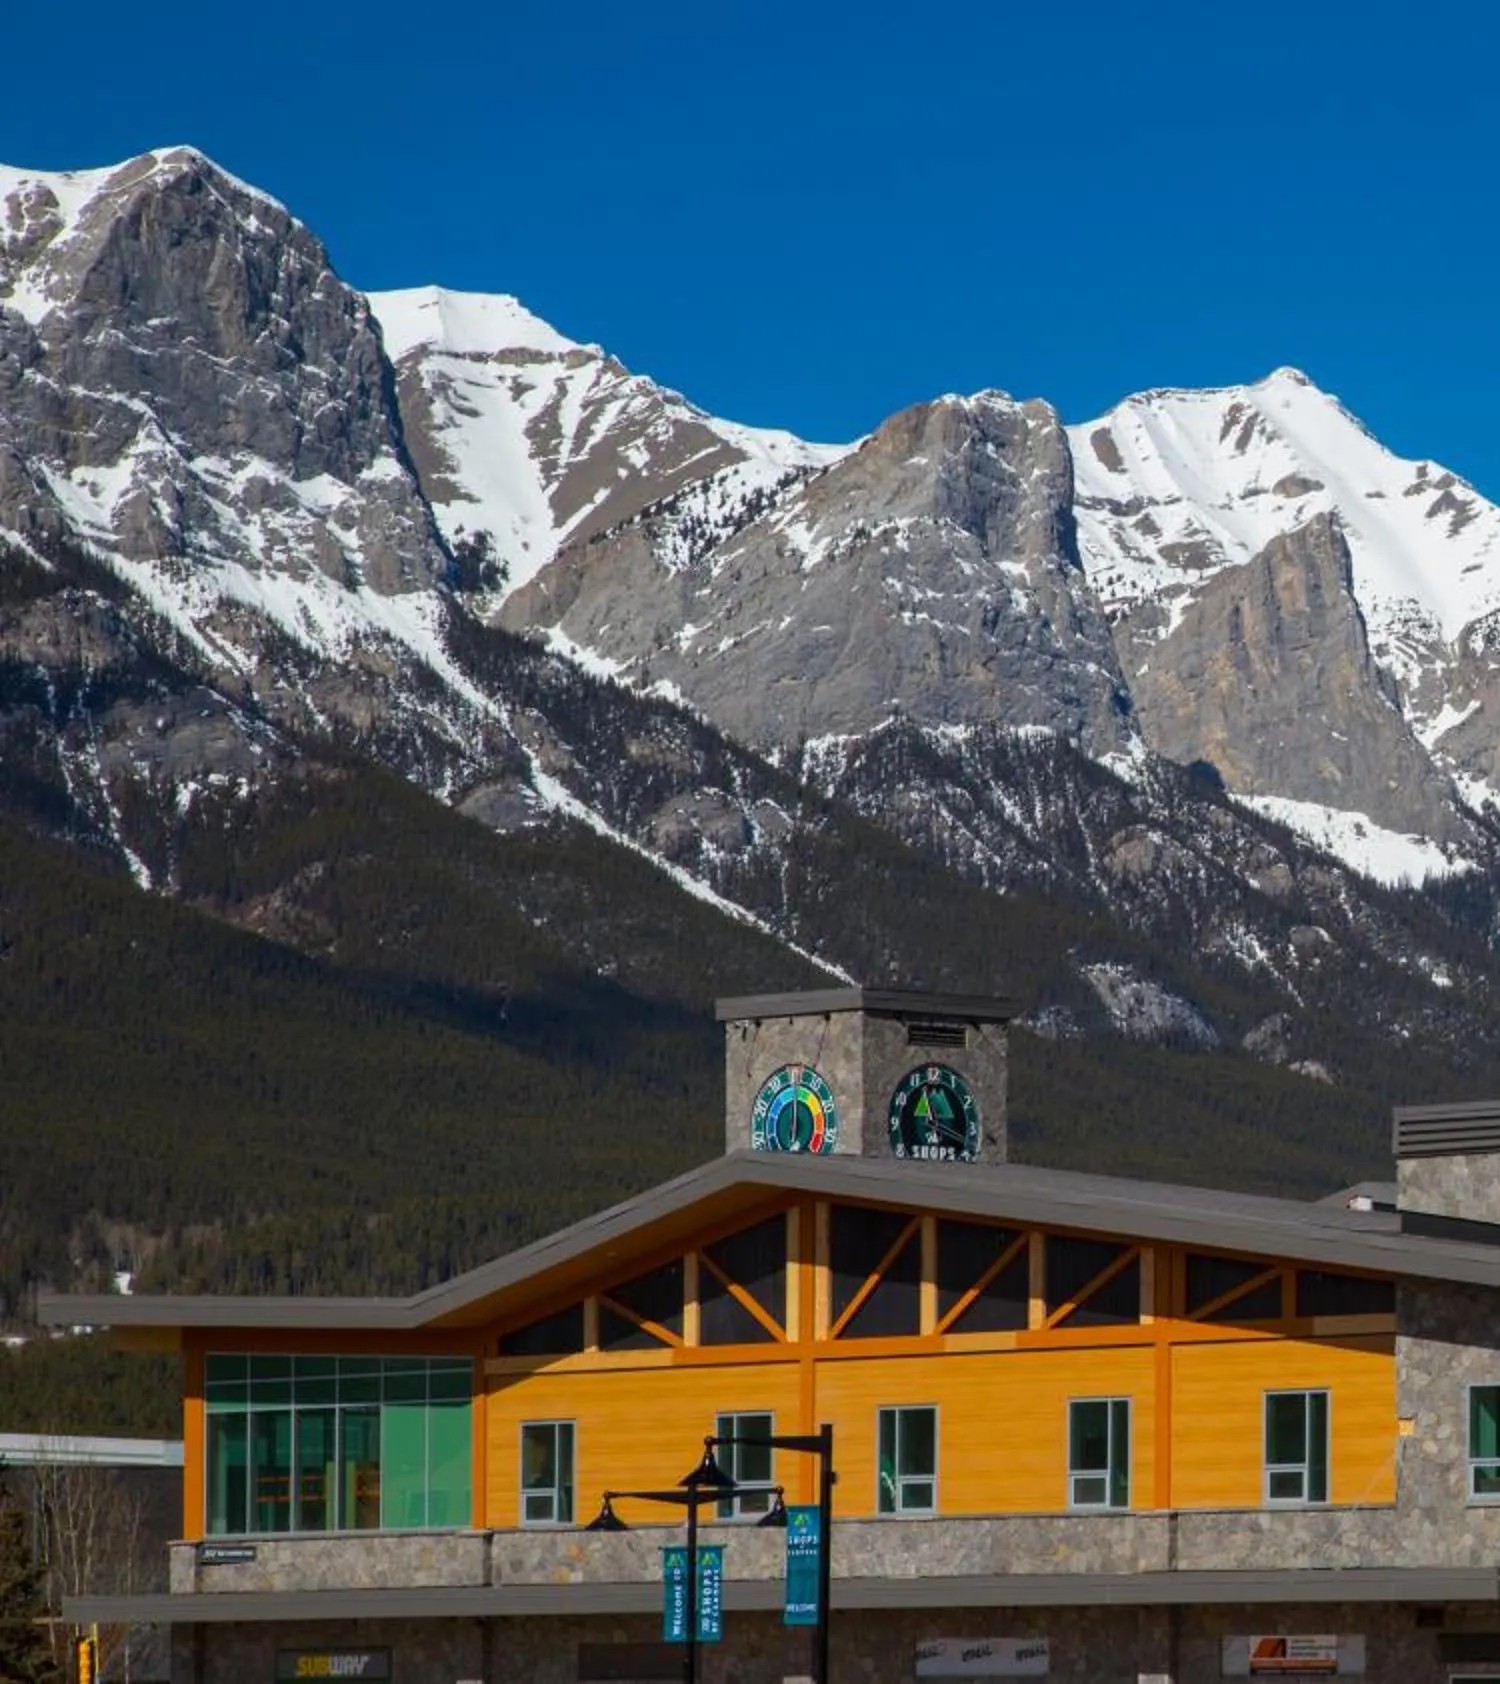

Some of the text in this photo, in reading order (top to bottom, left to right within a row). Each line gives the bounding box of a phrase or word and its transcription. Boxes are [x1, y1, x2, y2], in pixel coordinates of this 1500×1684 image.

[927, 1067, 941, 1082] 12
[963, 1095, 972, 1109] 2
[891, 1117, 899, 1131] 9
[969, 1121, 977, 1136] 3
[911, 1144, 957, 1161] SHOPS
[701, 1569, 713, 1616] SHOPS
[673, 1585, 683, 1635] WELCOME
[294, 1653, 369, 1678] SUBWAY
